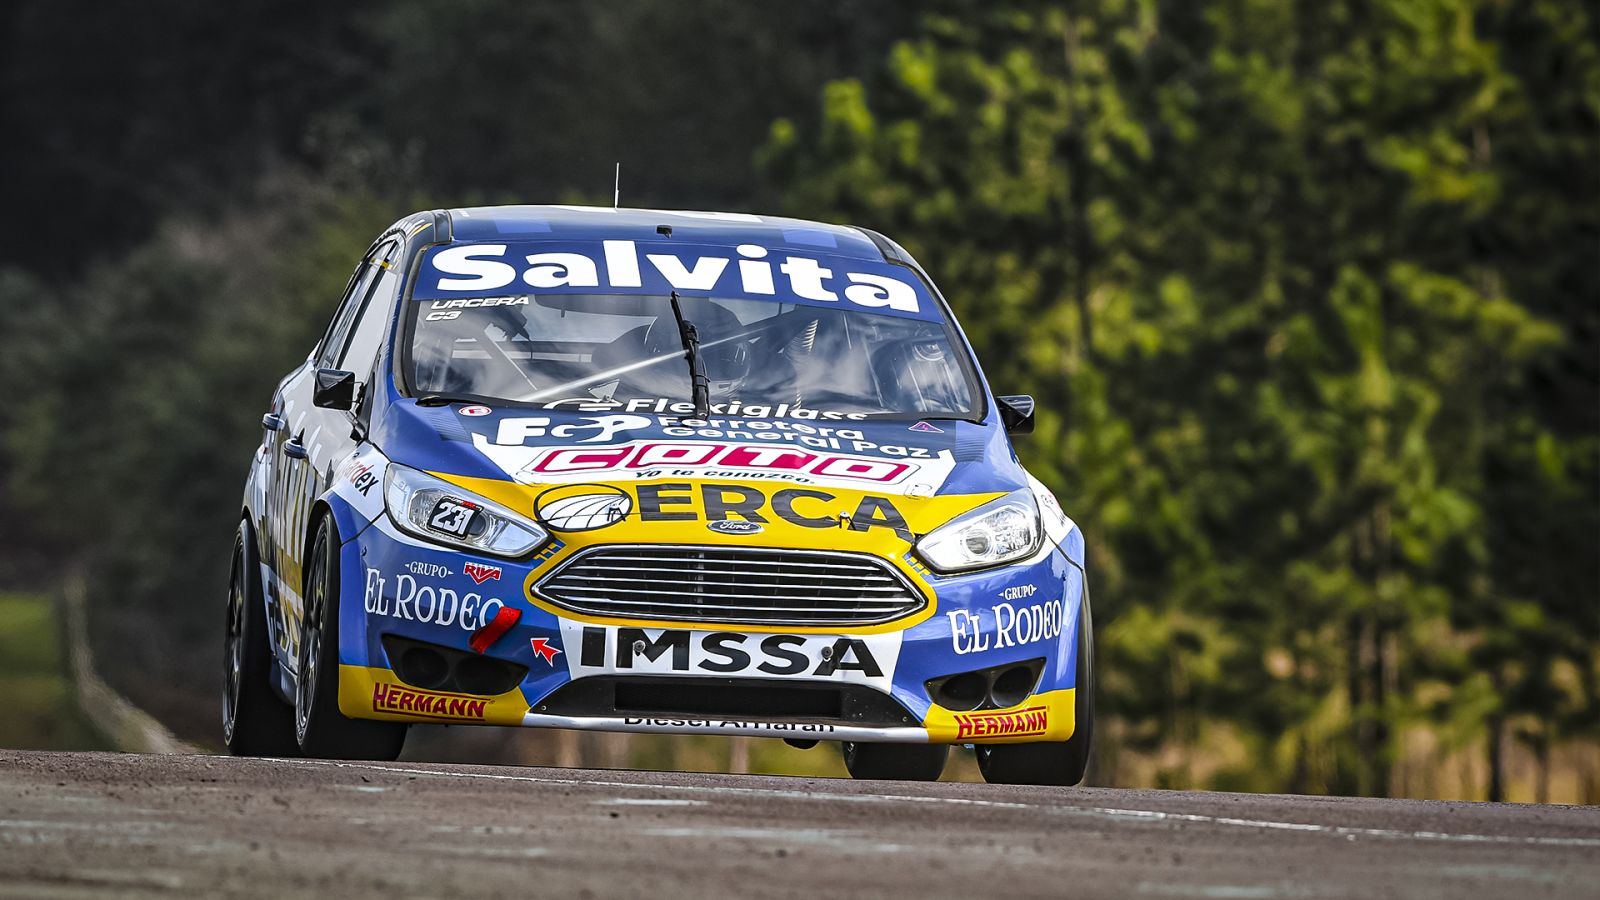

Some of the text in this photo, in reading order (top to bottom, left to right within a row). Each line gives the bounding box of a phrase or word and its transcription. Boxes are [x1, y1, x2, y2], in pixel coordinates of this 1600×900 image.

[432, 240, 920, 313] Salvita
[425, 310, 462, 321] C3
[657, 416, 865, 441] Ferretera
[662, 427, 931, 458] General Paz
[533, 443, 910, 482] COTO
[431, 501, 475, 535] 231
[635, 483, 915, 540] ERCA
[717, 518, 754, 531] Ford
[409, 560, 448, 579] GRUPO
[463, 561, 502, 585] RIVA
[364, 567, 389, 616] EL
[1004, 583, 1034, 601] GRUPO
[946, 609, 990, 655] EL
[580, 626, 885, 678] IMSSA
[373, 682, 487, 720] HERMANN
[953, 709, 1048, 739] HERMANN
